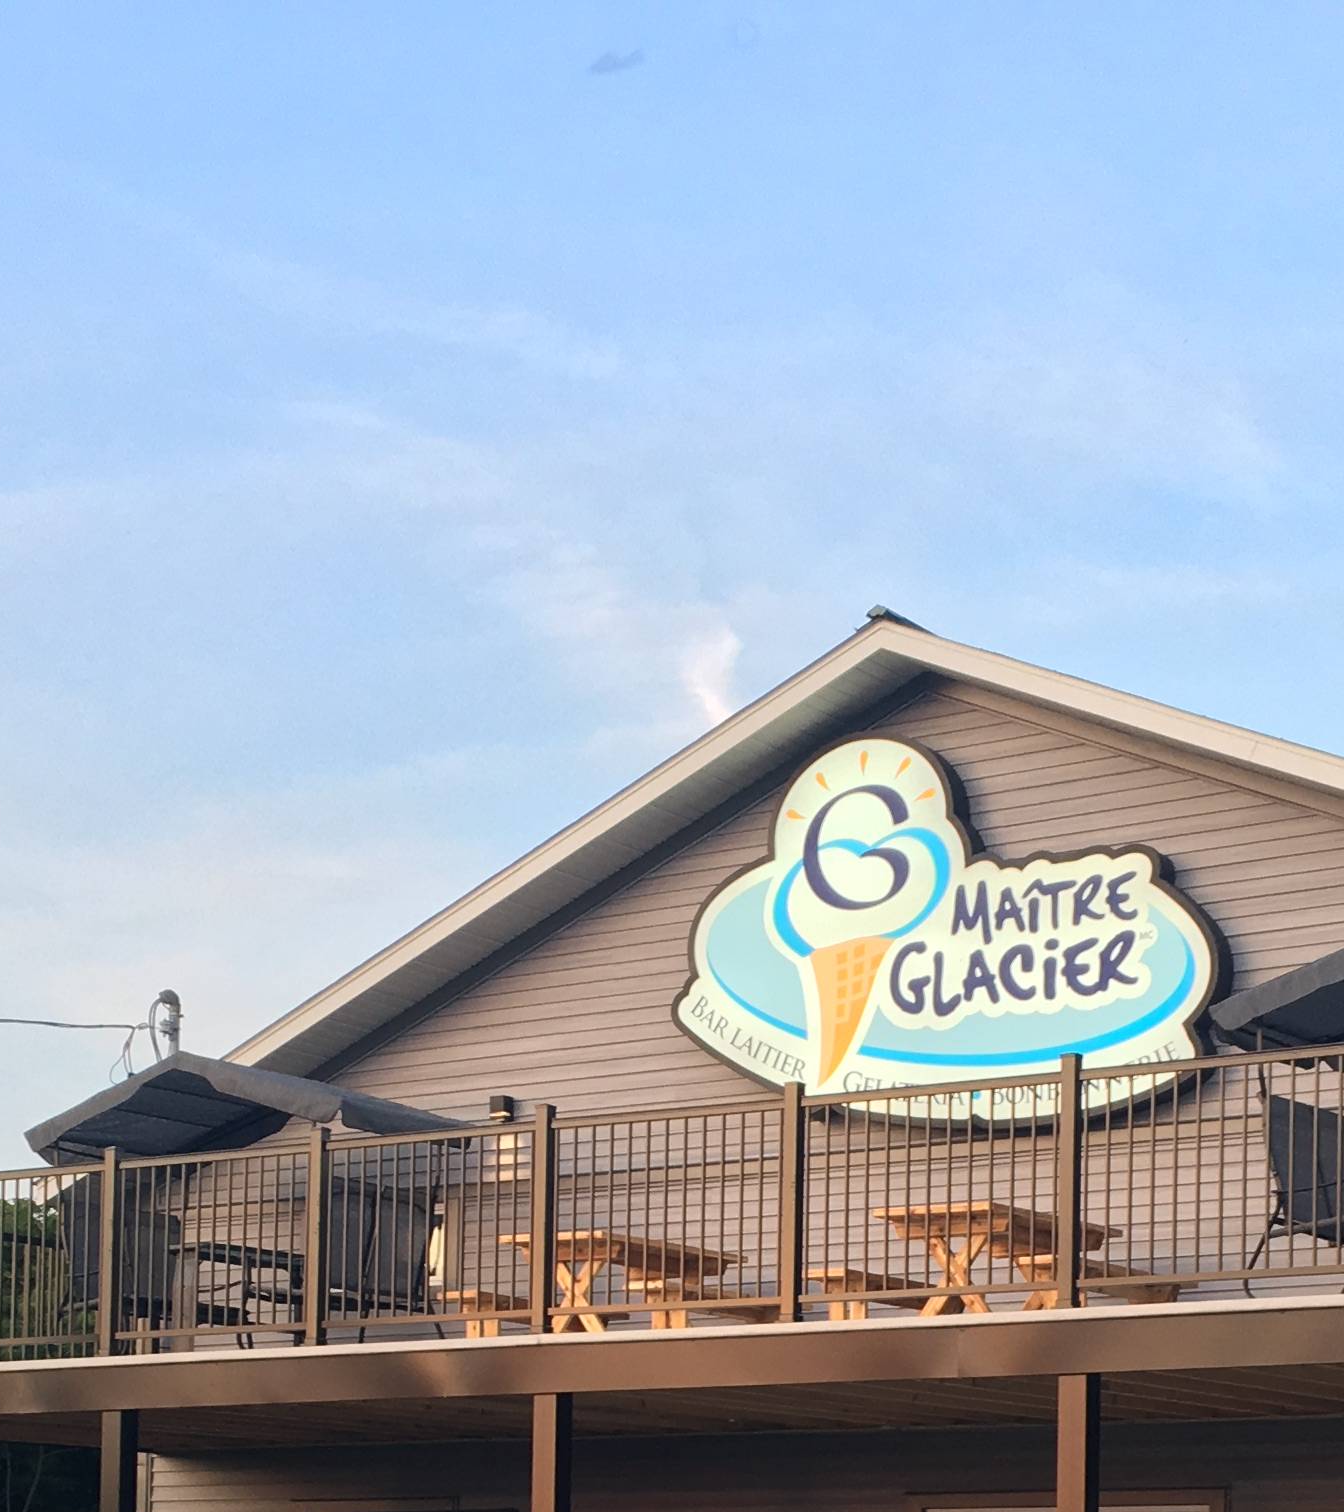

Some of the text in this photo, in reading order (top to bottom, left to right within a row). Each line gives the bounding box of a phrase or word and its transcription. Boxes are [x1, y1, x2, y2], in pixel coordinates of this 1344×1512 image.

[951, 870, 1139, 945] MAÎTRE
[691, 995, 729, 1040] BAR
[730, 1027, 807, 1081] LAITIER
[992, 1041, 1181, 1106] BONBNRIE
